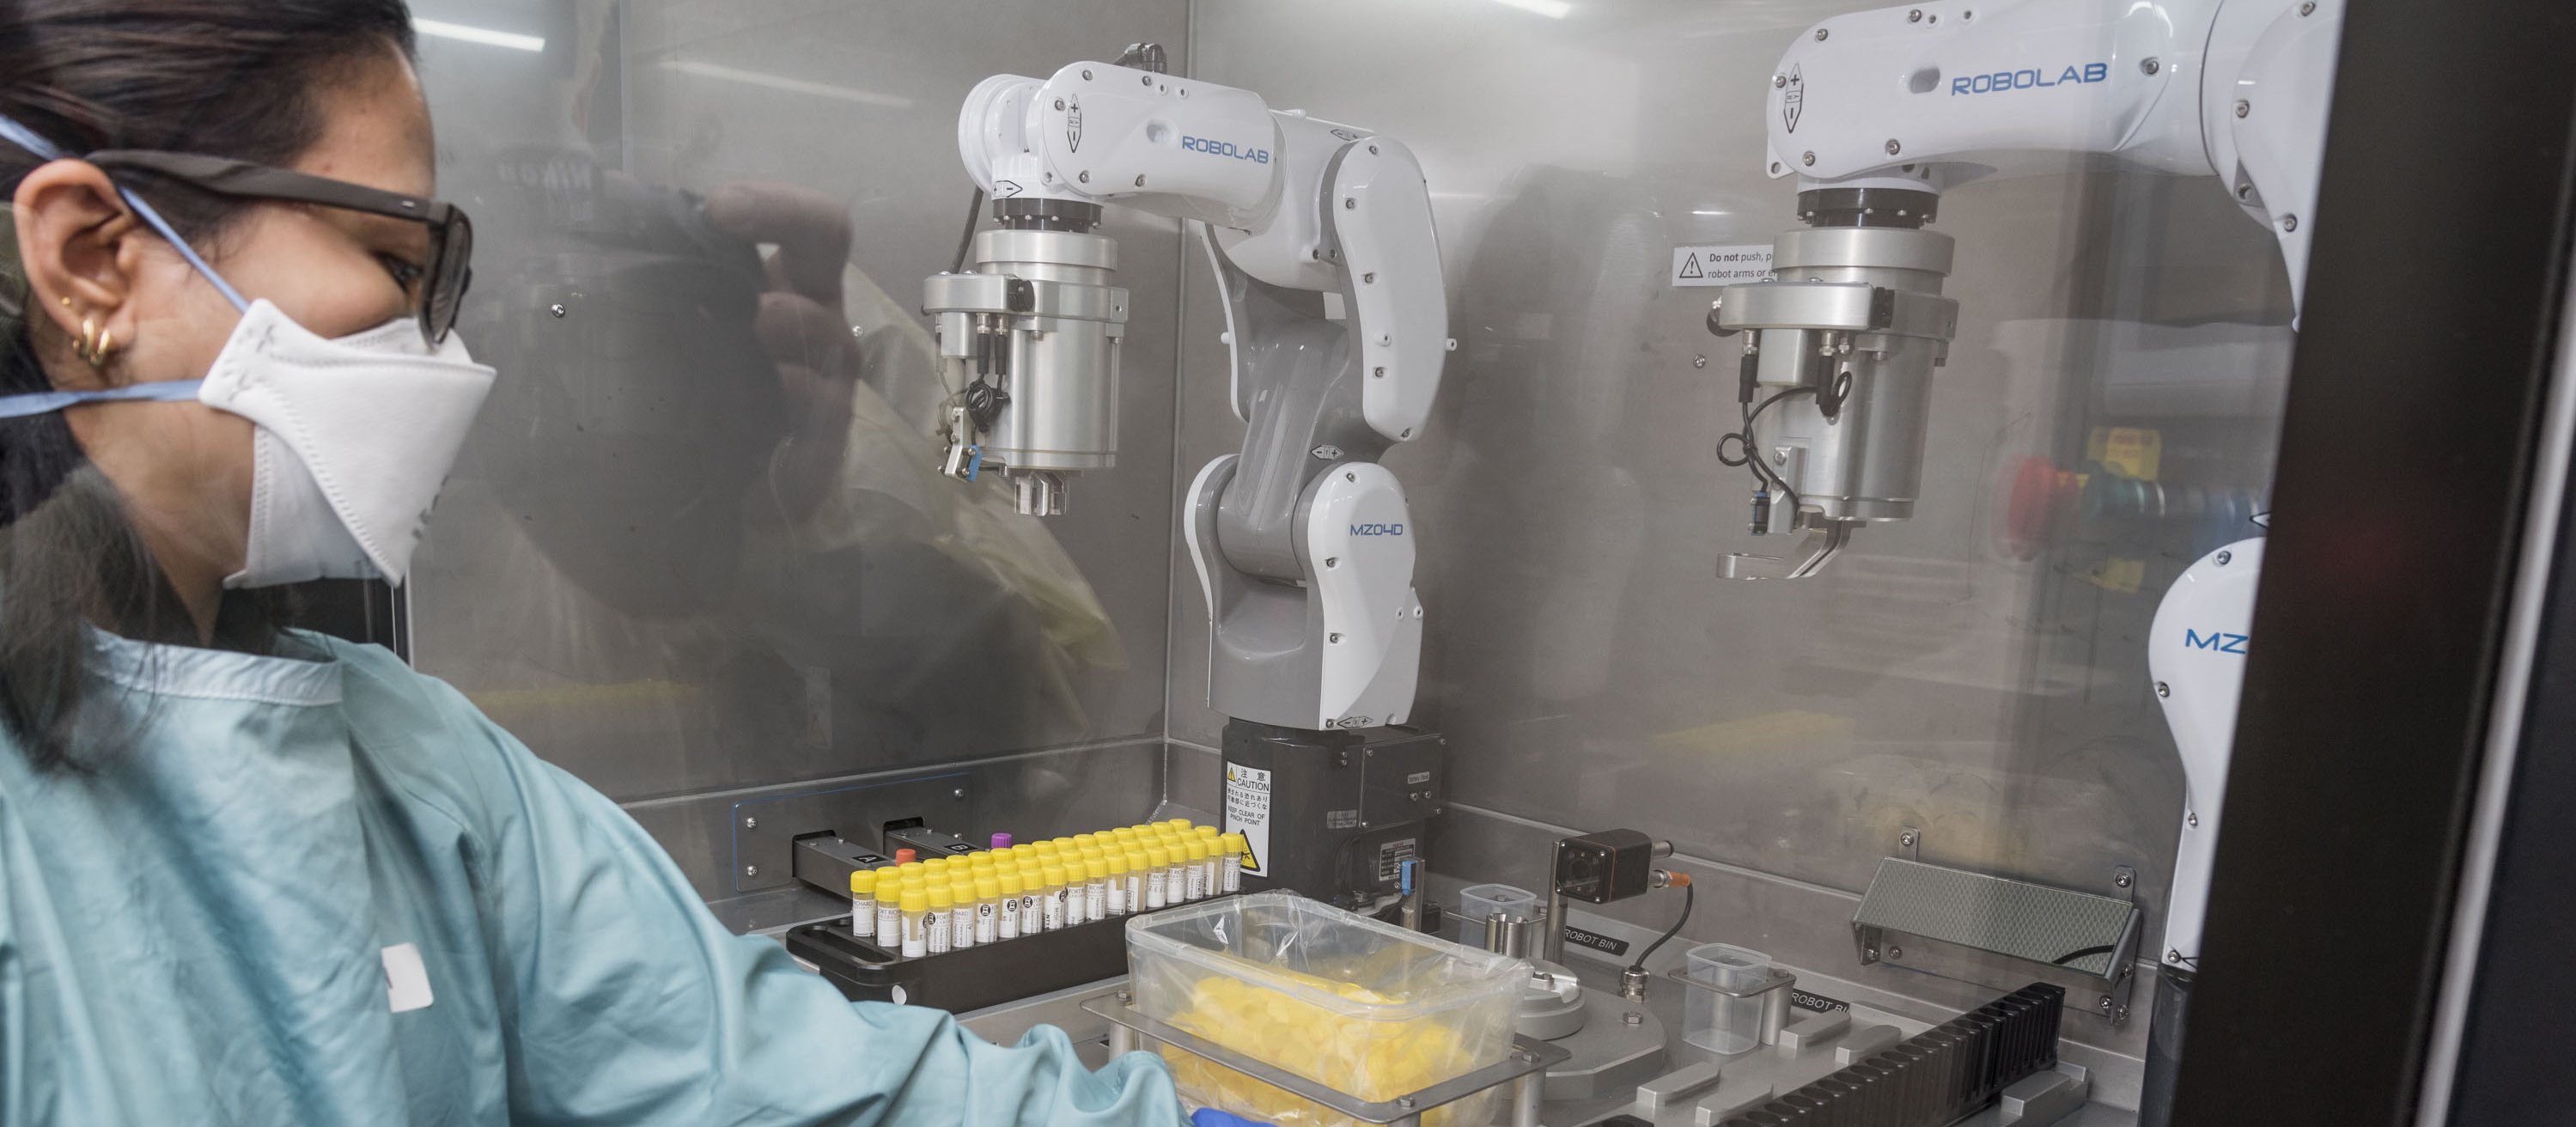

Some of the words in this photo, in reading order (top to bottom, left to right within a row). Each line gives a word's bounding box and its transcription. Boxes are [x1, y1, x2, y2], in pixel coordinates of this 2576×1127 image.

[1951, 62, 2108, 96] ROBOLAB
[1182, 135, 1270, 164] ROBOLAB
[1709, 253, 1721, 262] Do
[1723, 253, 1739, 262] not
[1741, 252, 1763, 263] push,
[1766, 253, 1773, 262] p
[1708, 270, 1731, 278] robot
[1350, 523, 1404, 536] MZ04D
[2185, 628, 2249, 655] MZ
[1237, 778, 1270, 791] CAUTION
[1230, 813, 1242, 823] PINCH
[1245, 817, 1260, 825] POINT
[1239, 809, 1255, 819] CLEAR
[1565, 929, 1599, 945] ROBOT
[1599, 939, 1617, 950] BIN
[1792, 992, 1833, 1010] ROBOT
[1835, 1004, 1848, 1013] BI
